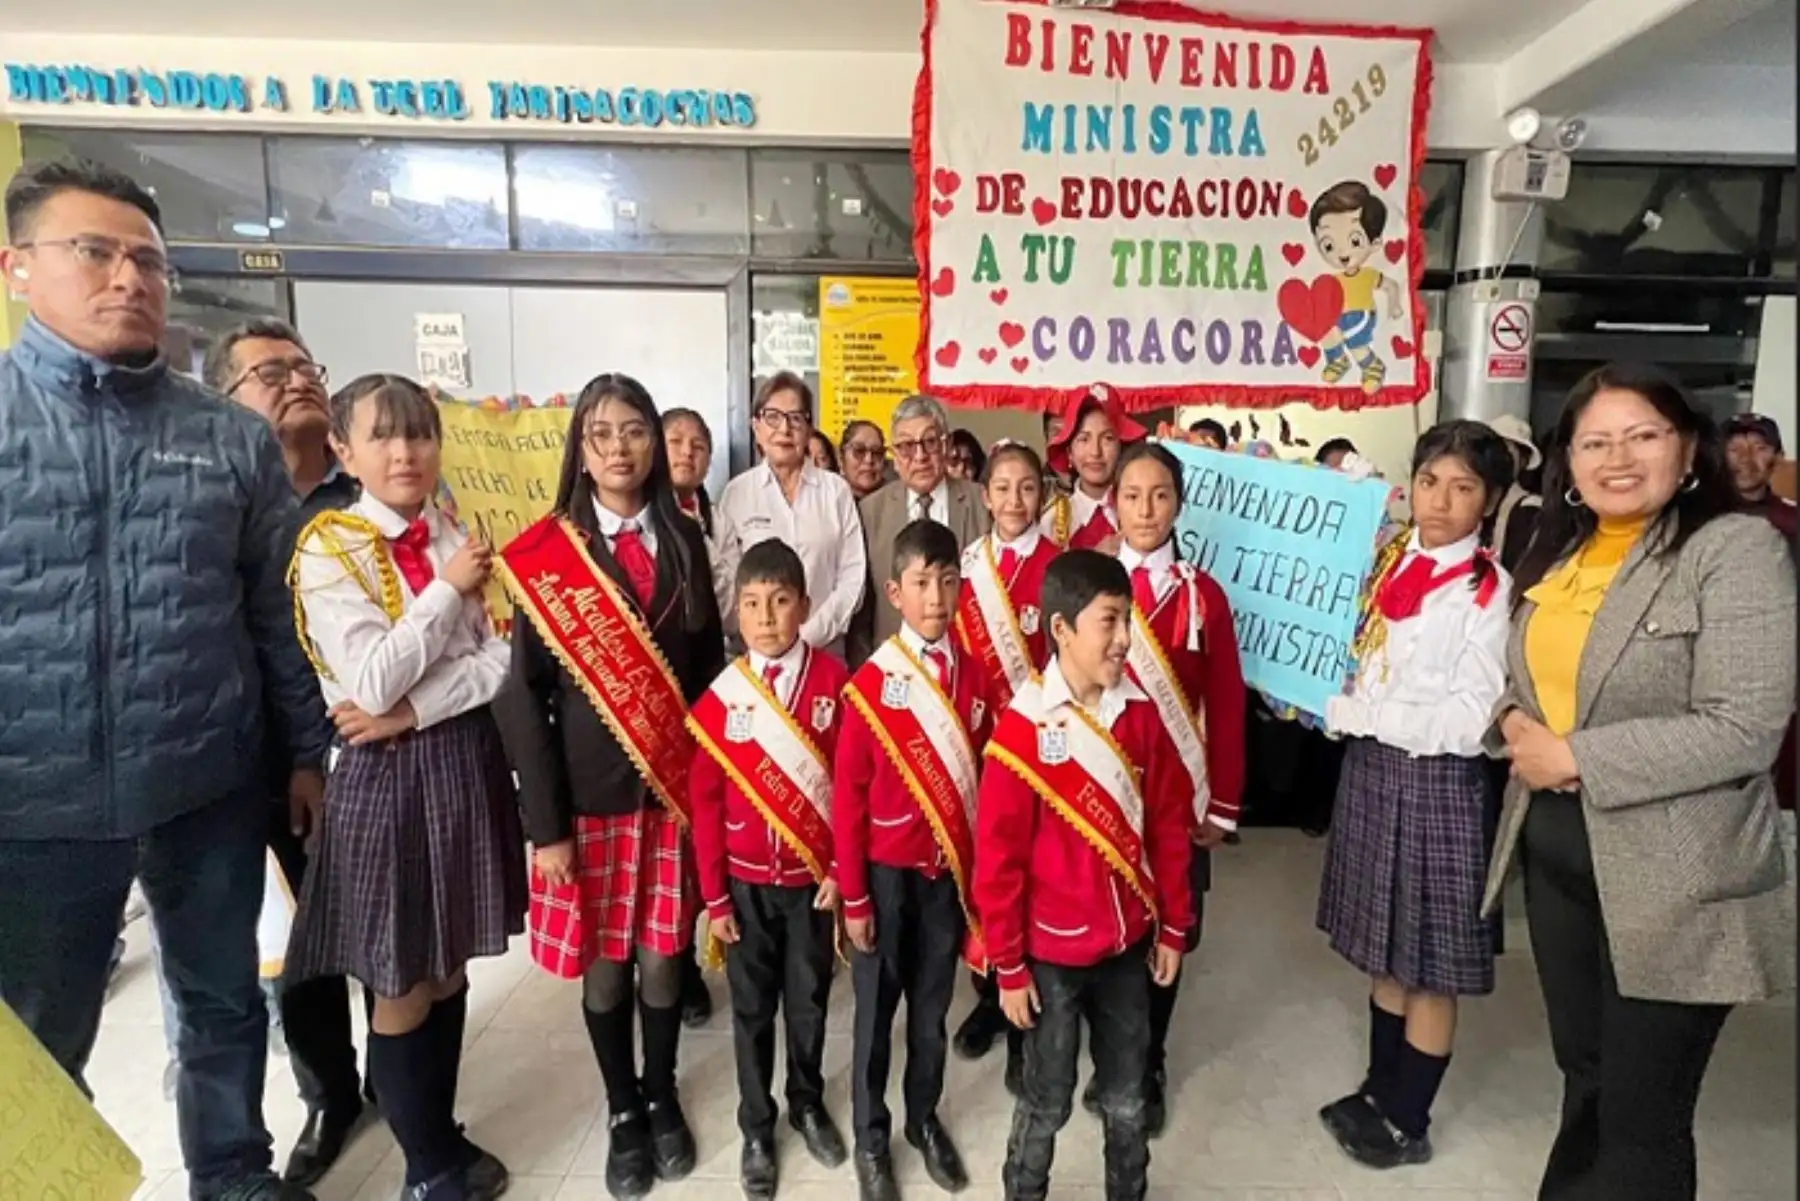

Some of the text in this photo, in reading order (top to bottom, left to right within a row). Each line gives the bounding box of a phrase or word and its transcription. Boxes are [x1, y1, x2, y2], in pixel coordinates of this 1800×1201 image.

[1004, 13, 1330, 95] BIENVENIDA
[262, 75, 288, 113] A
[312, 74, 362, 114] LA
[1297, 62, 1387, 167] 24219
[1021, 102, 1266, 157] MINISTRA
[976, 173, 1284, 220] DE EDUCACION
[972, 234, 1268, 291] A TU TIERRA
[422, 322, 459, 337] CAJA
[1032, 315, 1299, 366] CORACORA
[1184, 464, 1348, 543] IENVENIDA
[1181, 529, 1357, 619] SU TIERRA
[755, 755, 789, 802] Pedro
